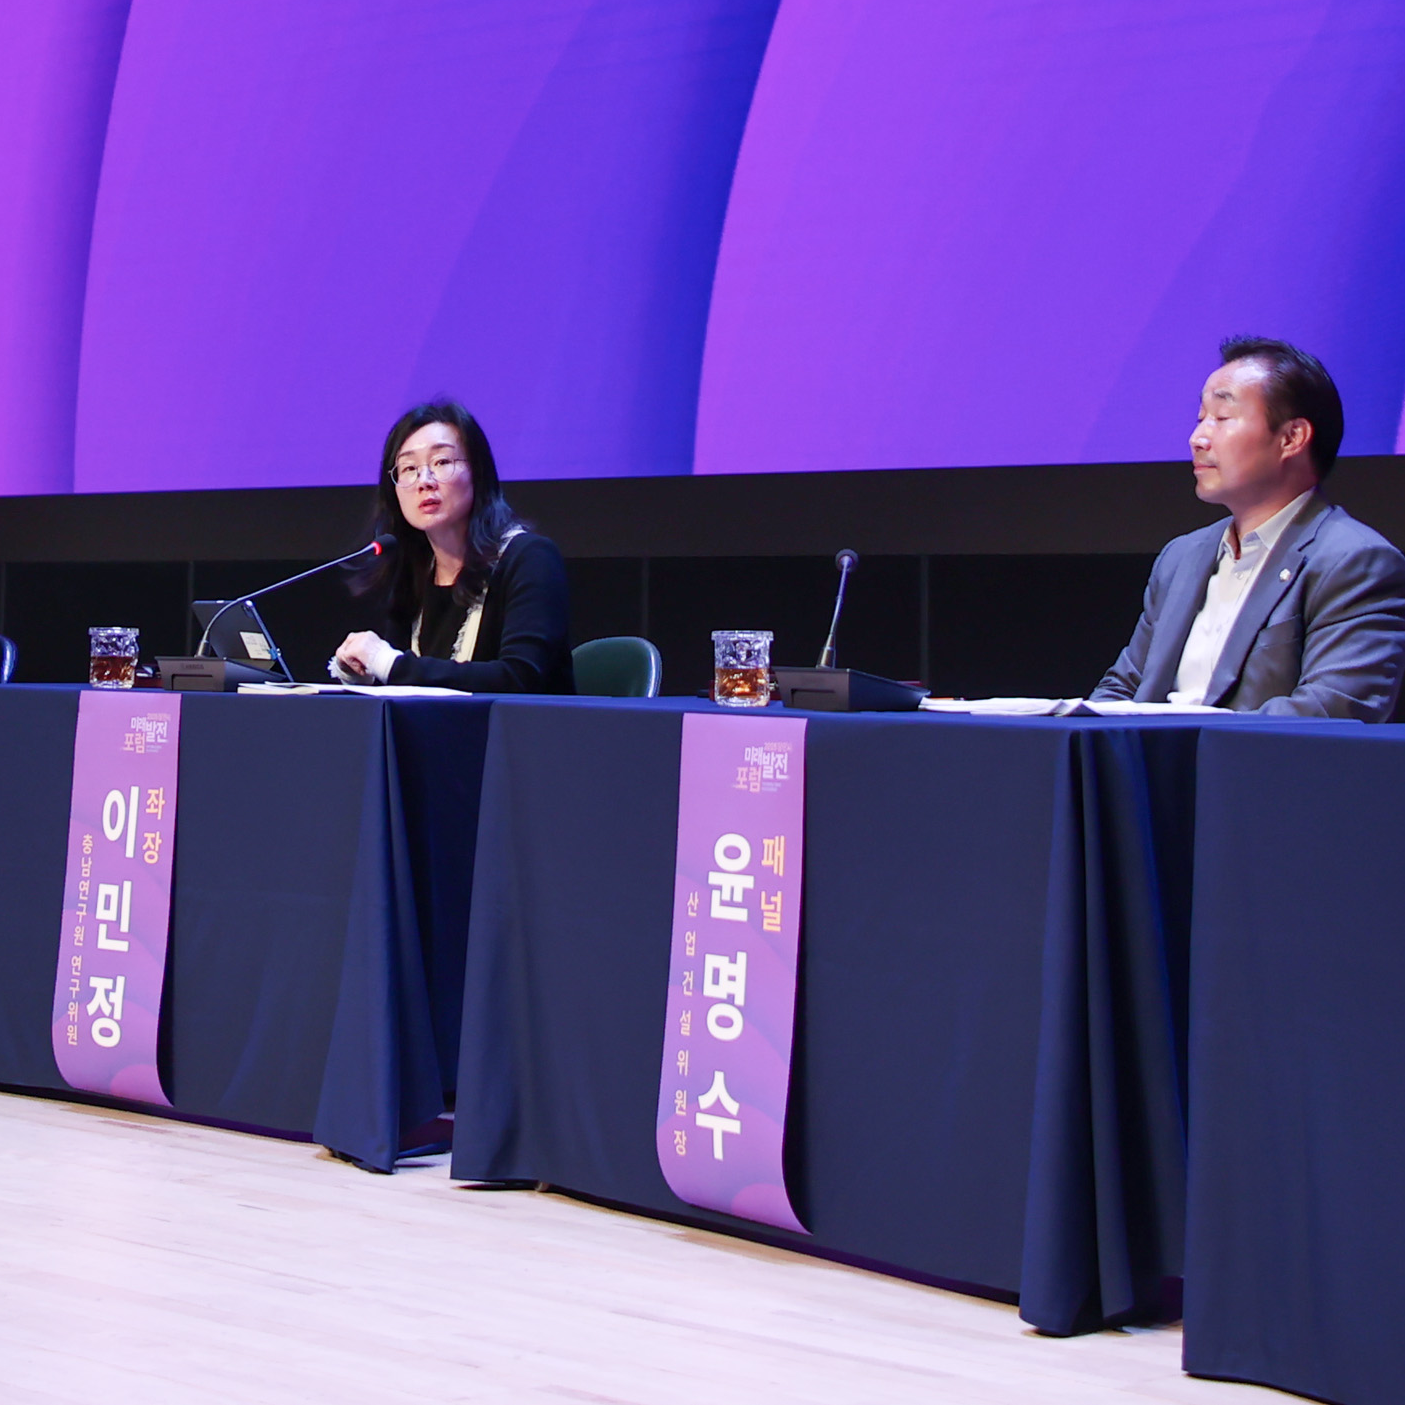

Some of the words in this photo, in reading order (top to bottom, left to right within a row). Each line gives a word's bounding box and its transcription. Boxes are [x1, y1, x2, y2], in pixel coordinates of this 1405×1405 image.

[142, 786, 166, 865] 좌장
[734, 766, 762, 793] 포럼
[73, 833, 94, 947] 충남연구원
[86, 785, 140, 1049] 이민정
[760, 834, 786, 934] 패널
[695, 832, 755, 1163] 윤명수
